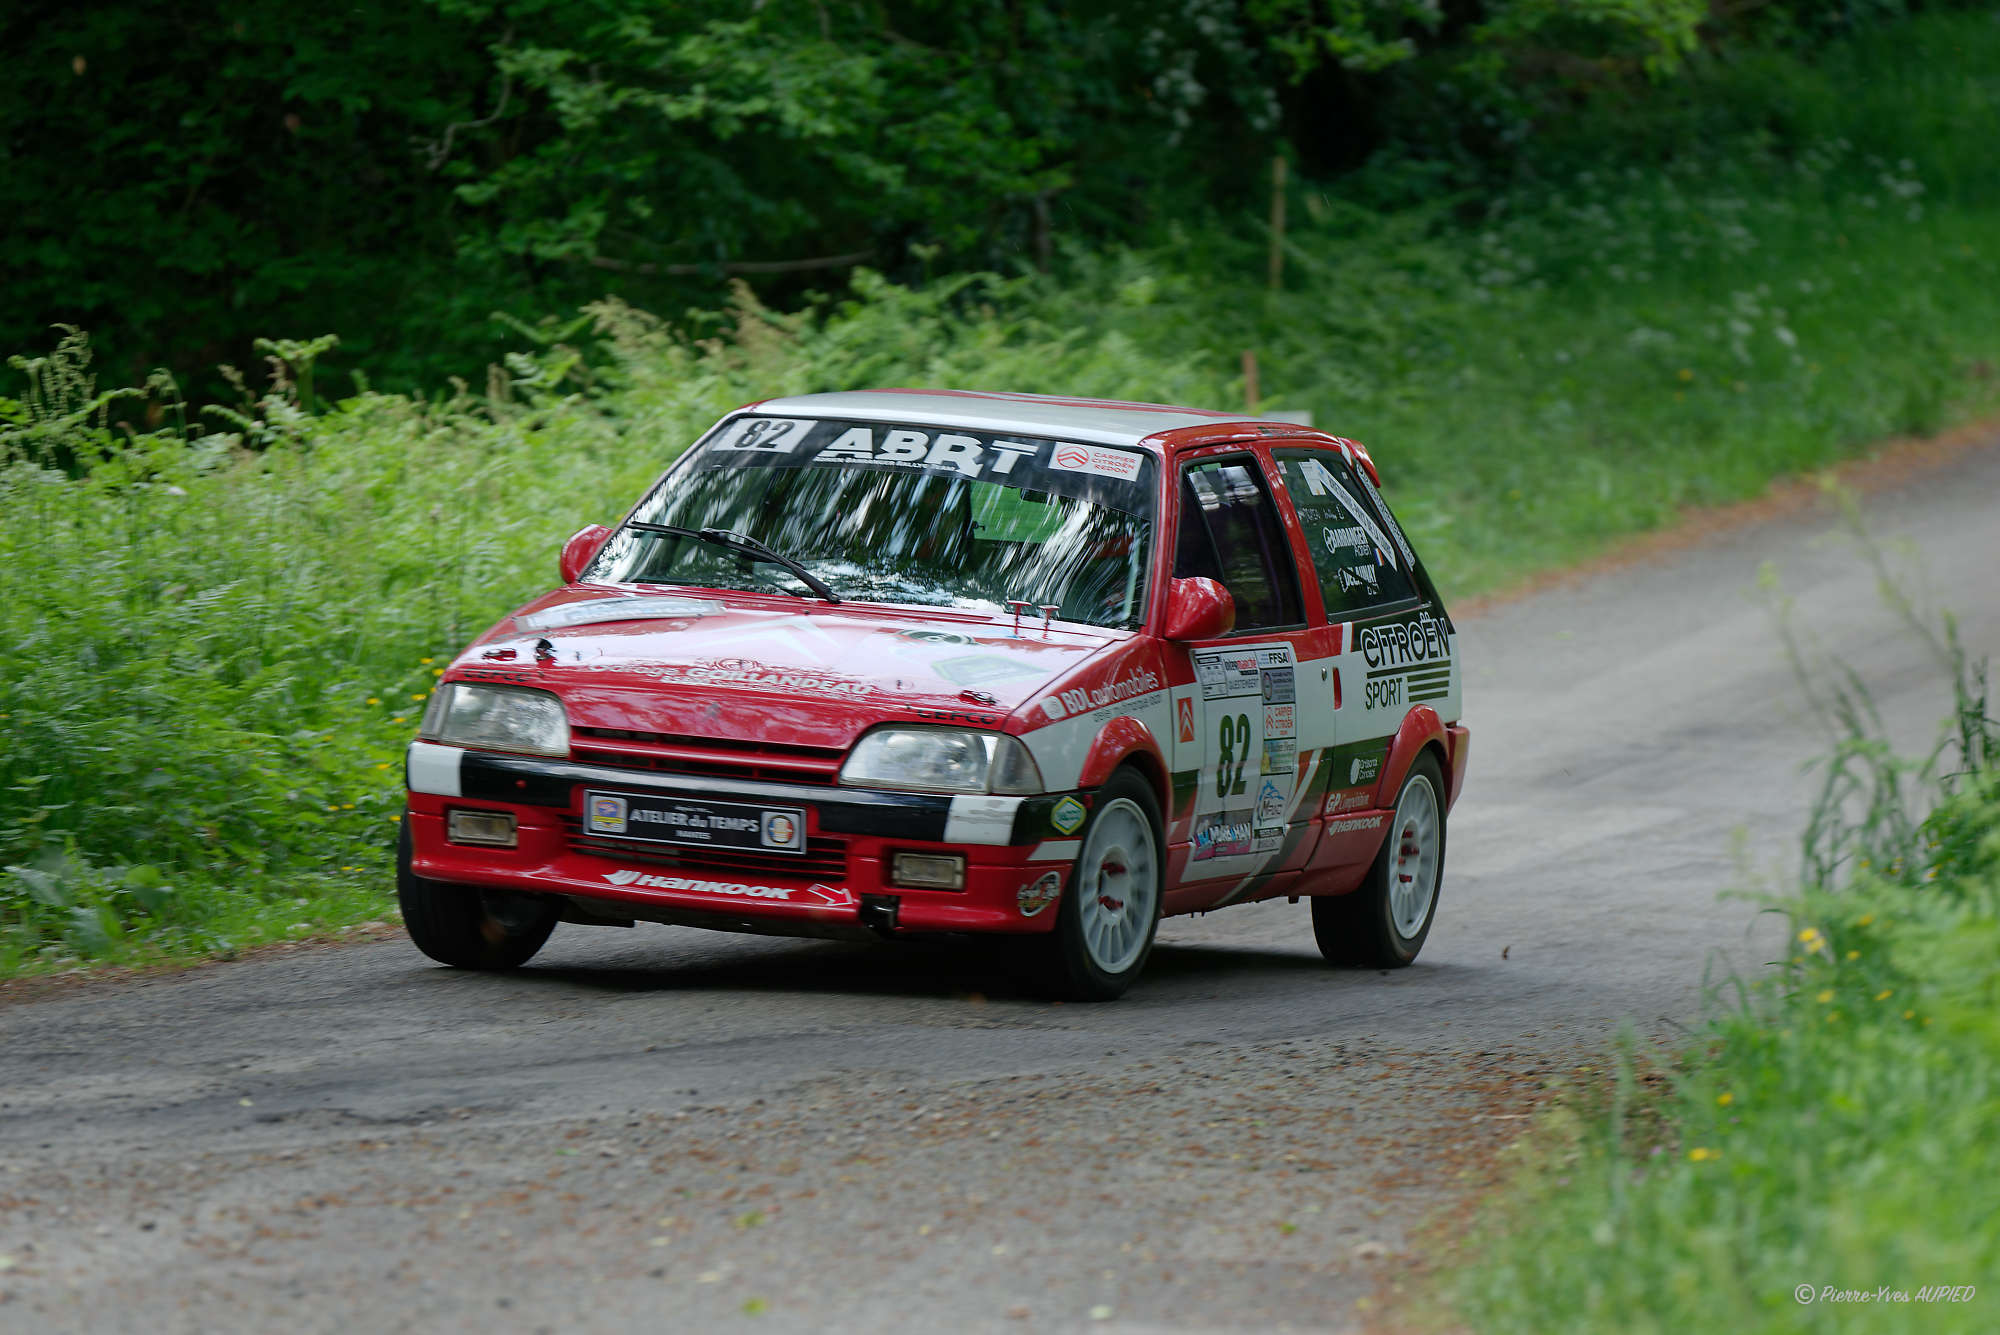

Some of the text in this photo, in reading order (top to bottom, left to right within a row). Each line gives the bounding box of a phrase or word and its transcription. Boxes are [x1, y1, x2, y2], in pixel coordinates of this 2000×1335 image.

[734, 419, 795, 449] 82
[817, 428, 1039, 478] ABRT
[1094, 452, 1137, 464] CARPIER
[1094, 464, 1129, 474] REDON
[1360, 613, 1451, 668] CITROËN
[1269, 651, 1289, 664] FFSA
[1060, 687, 1096, 714] BDL
[1091, 665, 1160, 704] automobiles
[1365, 678, 1403, 710] SPORT
[1216, 713, 1251, 798] 82
[1327, 794, 1340, 813] GP
[629, 809, 689, 826] ATELIER
[688, 813, 708, 828] du
[709, 816, 760, 833] TEMPS
